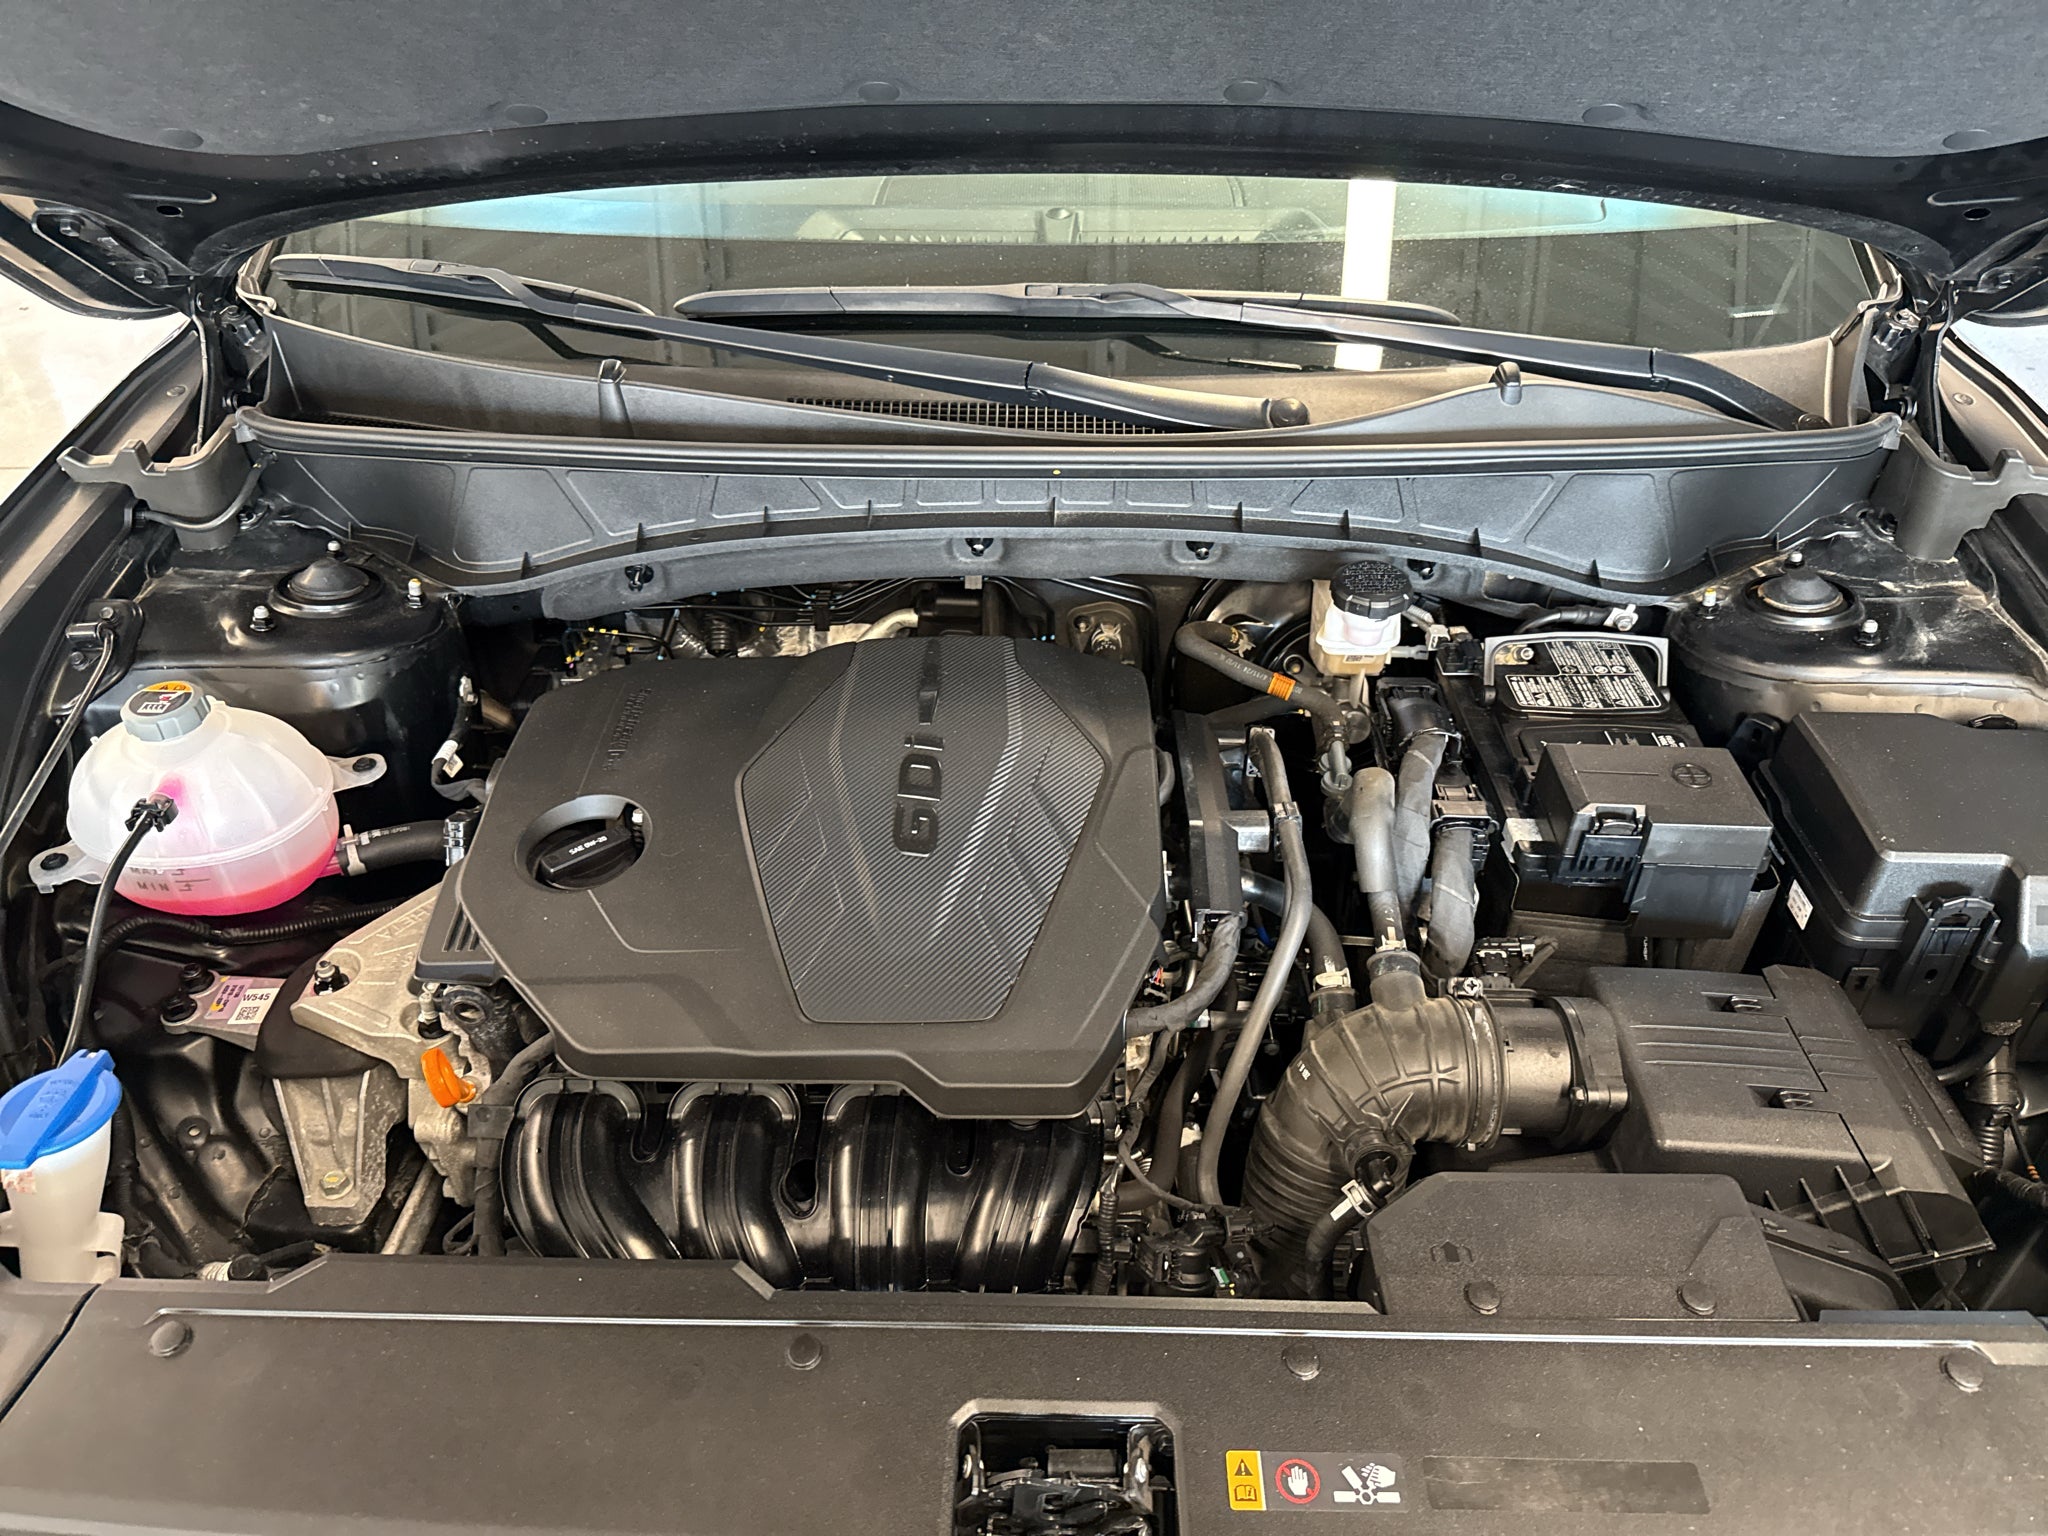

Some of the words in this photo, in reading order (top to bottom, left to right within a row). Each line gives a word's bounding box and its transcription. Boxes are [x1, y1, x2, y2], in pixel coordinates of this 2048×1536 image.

[569, 844, 586, 855] SAE
[584, 835, 608, 849] 0W-20
[137, 882, 170, 892] MIN
[243, 992, 271, 1001] W545
